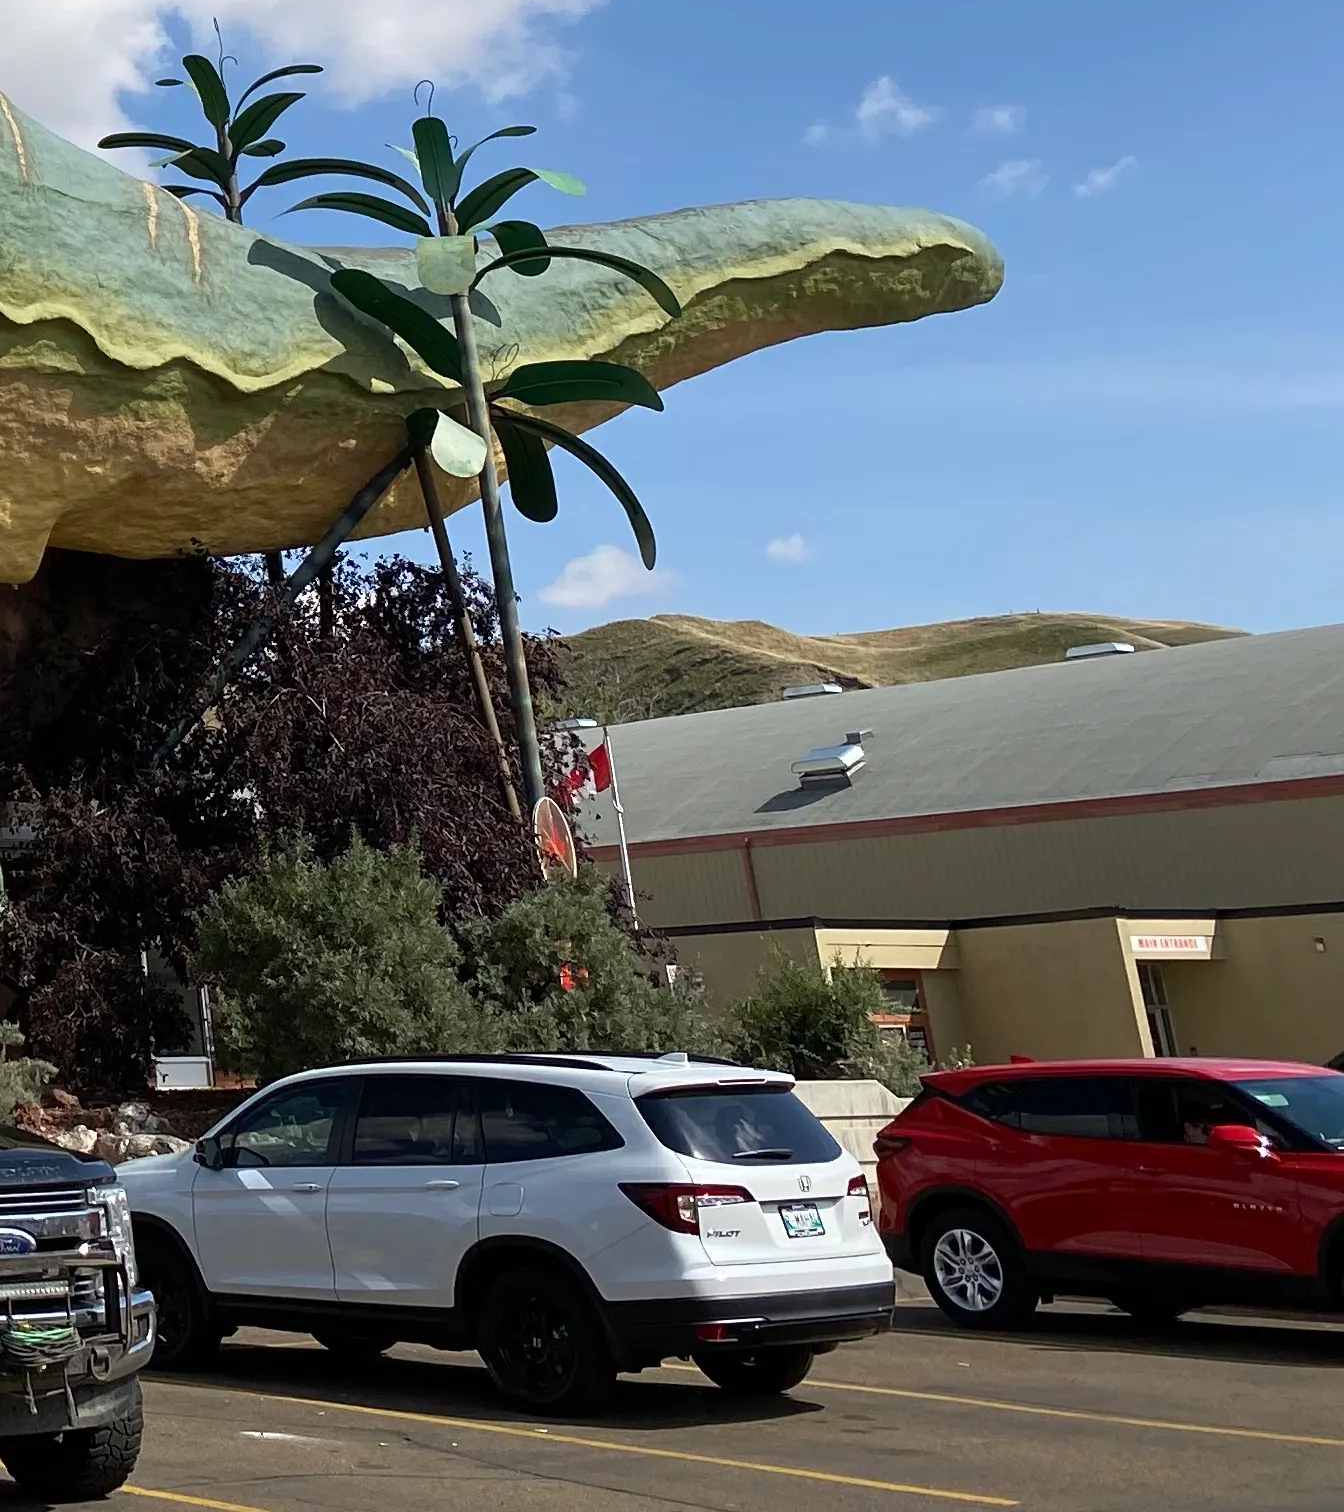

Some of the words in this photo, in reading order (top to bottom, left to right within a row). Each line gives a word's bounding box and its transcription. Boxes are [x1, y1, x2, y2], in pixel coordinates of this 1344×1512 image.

[1138, 939, 1158, 949] MAIN
[1159, 939, 1198, 949] ENTRANCE
[707, 1229, 741, 1238] PILOT
